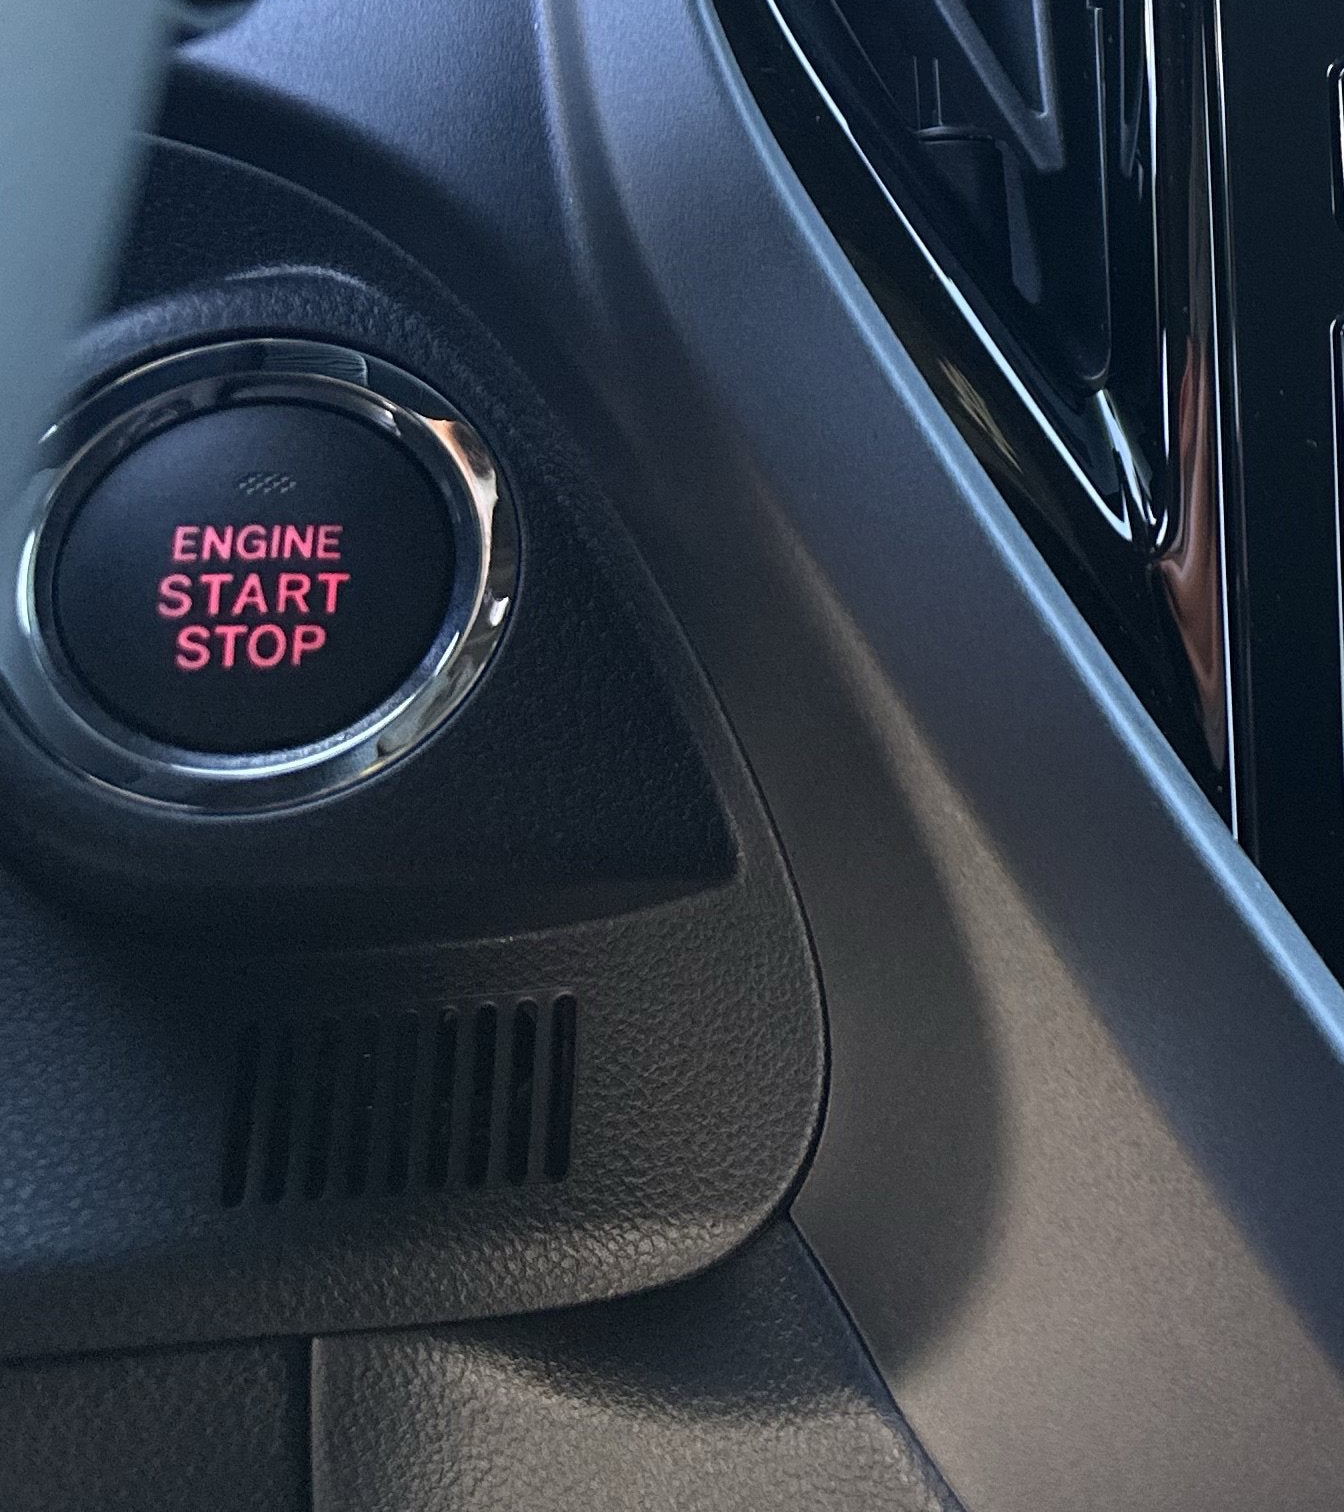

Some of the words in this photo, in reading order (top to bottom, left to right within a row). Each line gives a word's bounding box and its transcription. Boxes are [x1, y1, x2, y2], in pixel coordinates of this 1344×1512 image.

[171, 523, 344, 564] ENGINE
[156, 571, 351, 621] START
[173, 623, 328, 672] STOP
